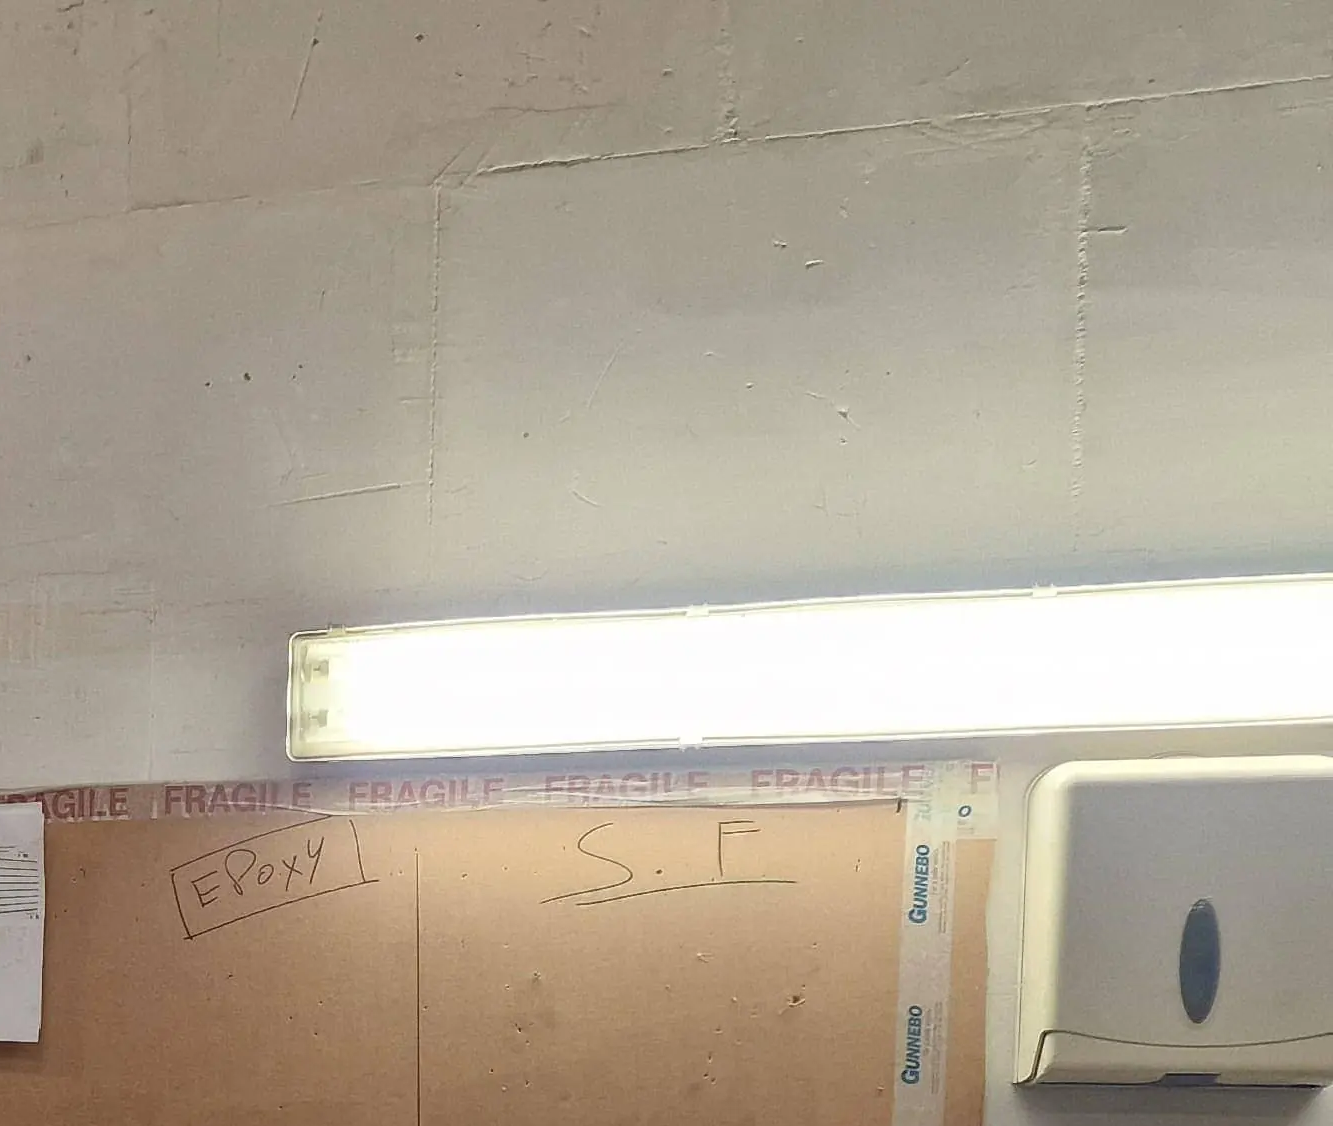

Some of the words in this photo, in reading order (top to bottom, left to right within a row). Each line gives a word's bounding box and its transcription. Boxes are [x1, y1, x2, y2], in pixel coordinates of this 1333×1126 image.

[164, 782, 313, 817] FRAGILE
[348, 777, 505, 809] FRAGILE
[751, 764, 926, 798] FRAGILE
[909, 844, 930, 924] GUNNEBO
[900, 1005, 923, 1085] GUNNEBO
